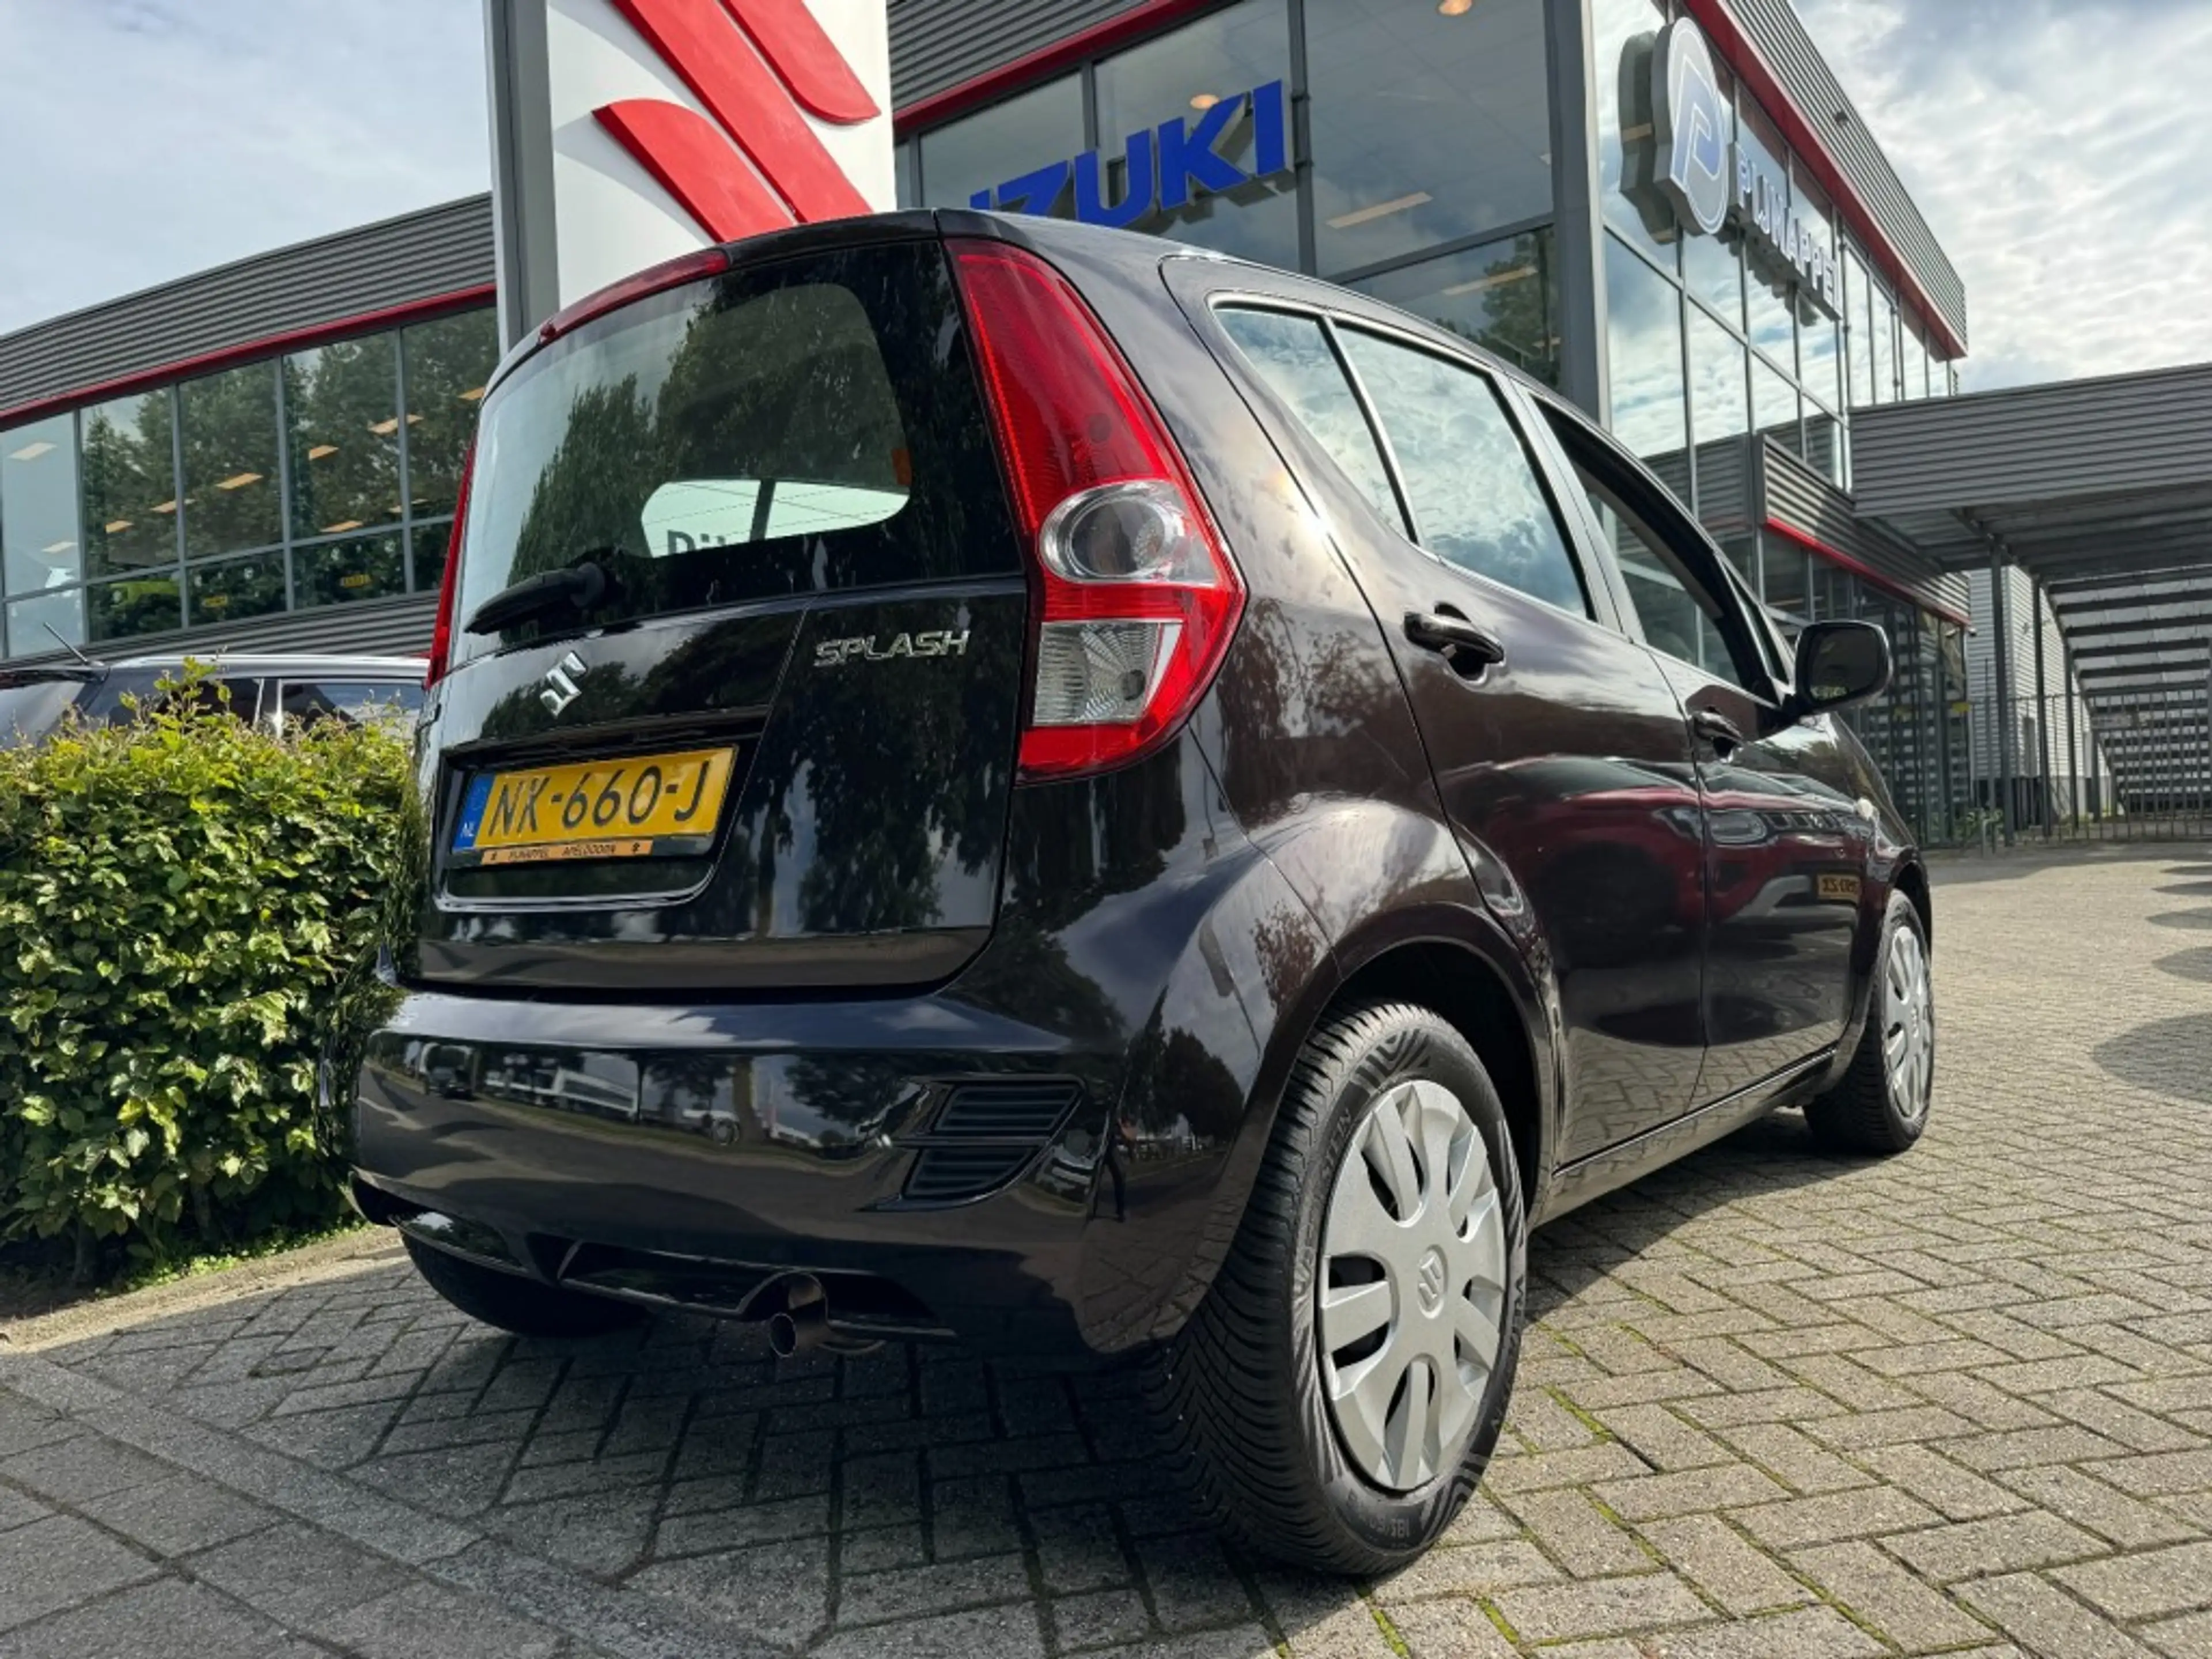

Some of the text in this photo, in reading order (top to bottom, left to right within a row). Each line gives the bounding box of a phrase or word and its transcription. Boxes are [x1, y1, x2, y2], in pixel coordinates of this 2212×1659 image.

[970, 79, 1285, 229] ZUKI
[813, 630, 970, 666] SPLASH
[488, 760, 709, 838] NK-660-J
